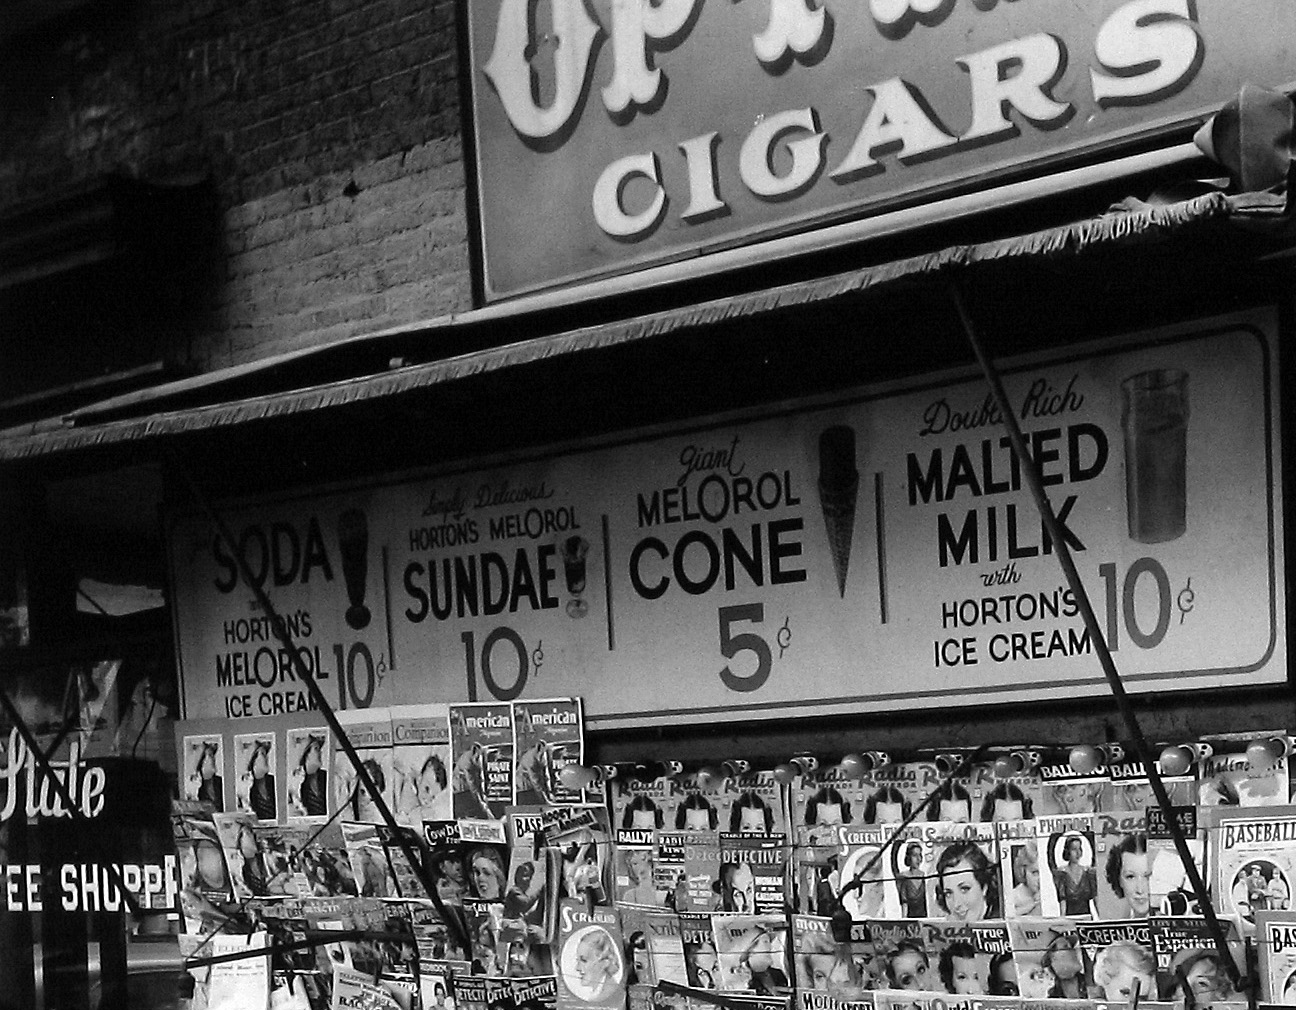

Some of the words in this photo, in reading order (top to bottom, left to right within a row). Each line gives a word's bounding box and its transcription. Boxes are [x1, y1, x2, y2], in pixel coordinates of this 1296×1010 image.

[592, 0, 1203, 238] CIGARS
[1021, 374, 1084, 420] Rich
[907, 423, 1109, 506] MALTED
[638, 470, 801, 528] MELOROL
[409, 519, 479, 552] HORTON'S
[490, 505, 581, 542] MELOROL
[938, 495, 1086, 567] MILK
[212, 518, 336, 596] SODA
[630, 518, 808, 600] CONE
[979, 563, 1021, 588] with
[405, 545, 559, 622] SUNDAE
[223, 610, 314, 645] HORTON'S
[942, 587, 1079, 629] HORTON'S
[216, 643, 330, 689] MELOROL
[935, 638, 978, 668] ICE
[989, 627, 1092, 663] CREAM
[225, 692, 255, 720] ICE
[722, 849, 782, 865] DETECTIVE
